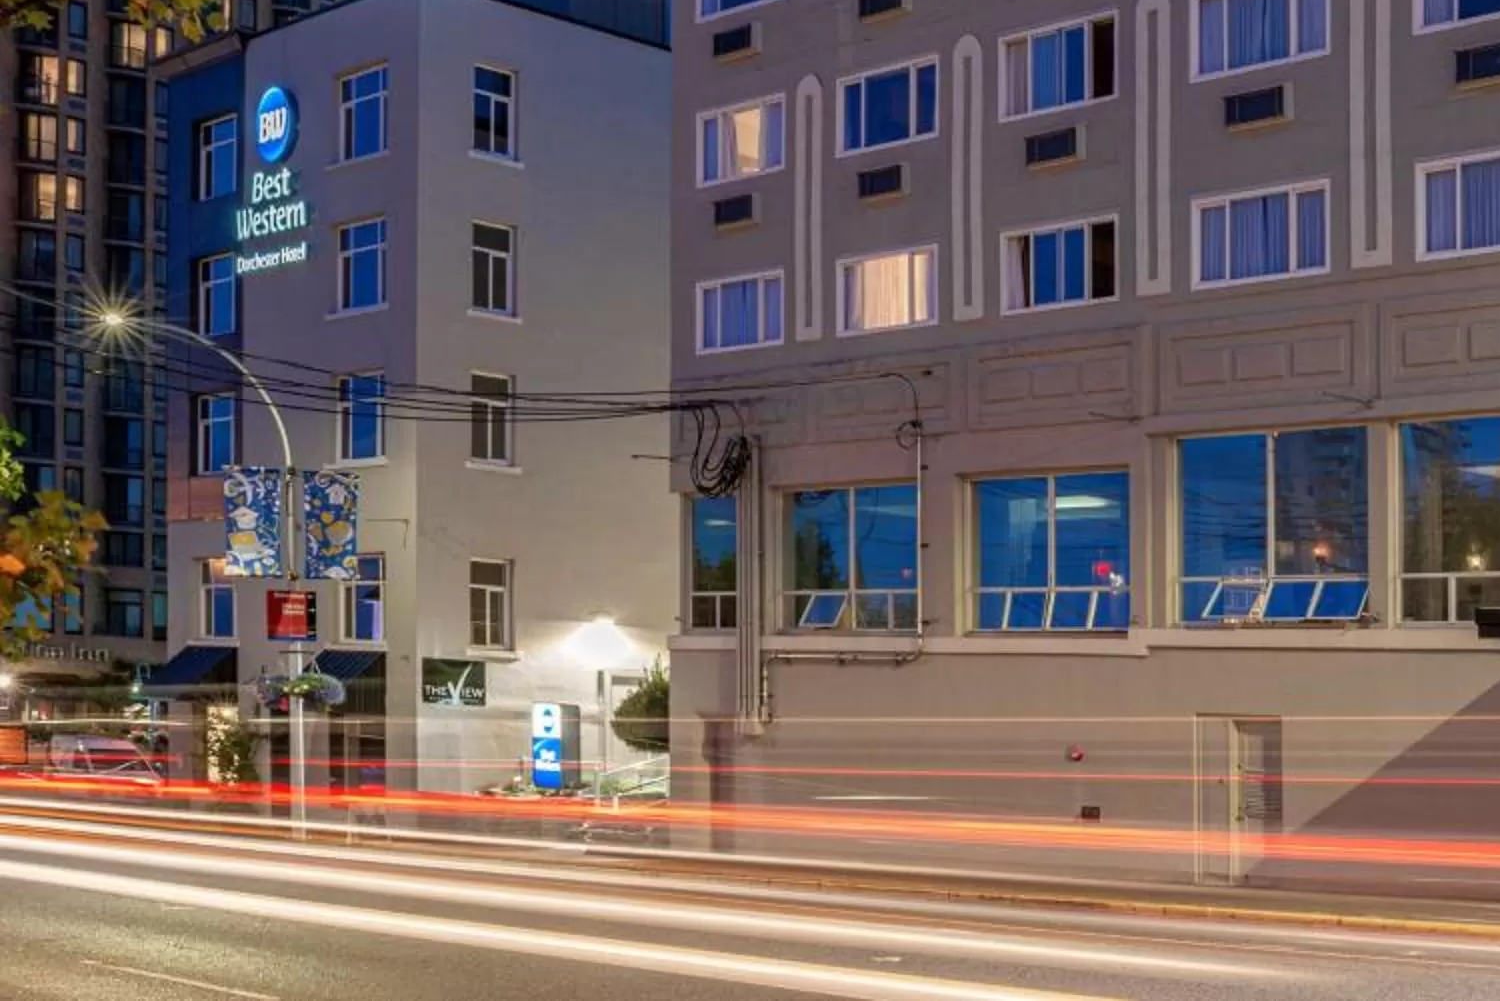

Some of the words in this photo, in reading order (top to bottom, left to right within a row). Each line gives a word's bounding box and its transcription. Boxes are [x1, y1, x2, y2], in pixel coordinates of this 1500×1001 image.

[258, 107, 287, 144] BW
[251, 166, 292, 204] Best
[236, 200, 306, 241] Western
[237, 250, 280, 274] Dorchester
[281, 242, 307, 264] Hotel
[425, 684, 448, 696] THE
